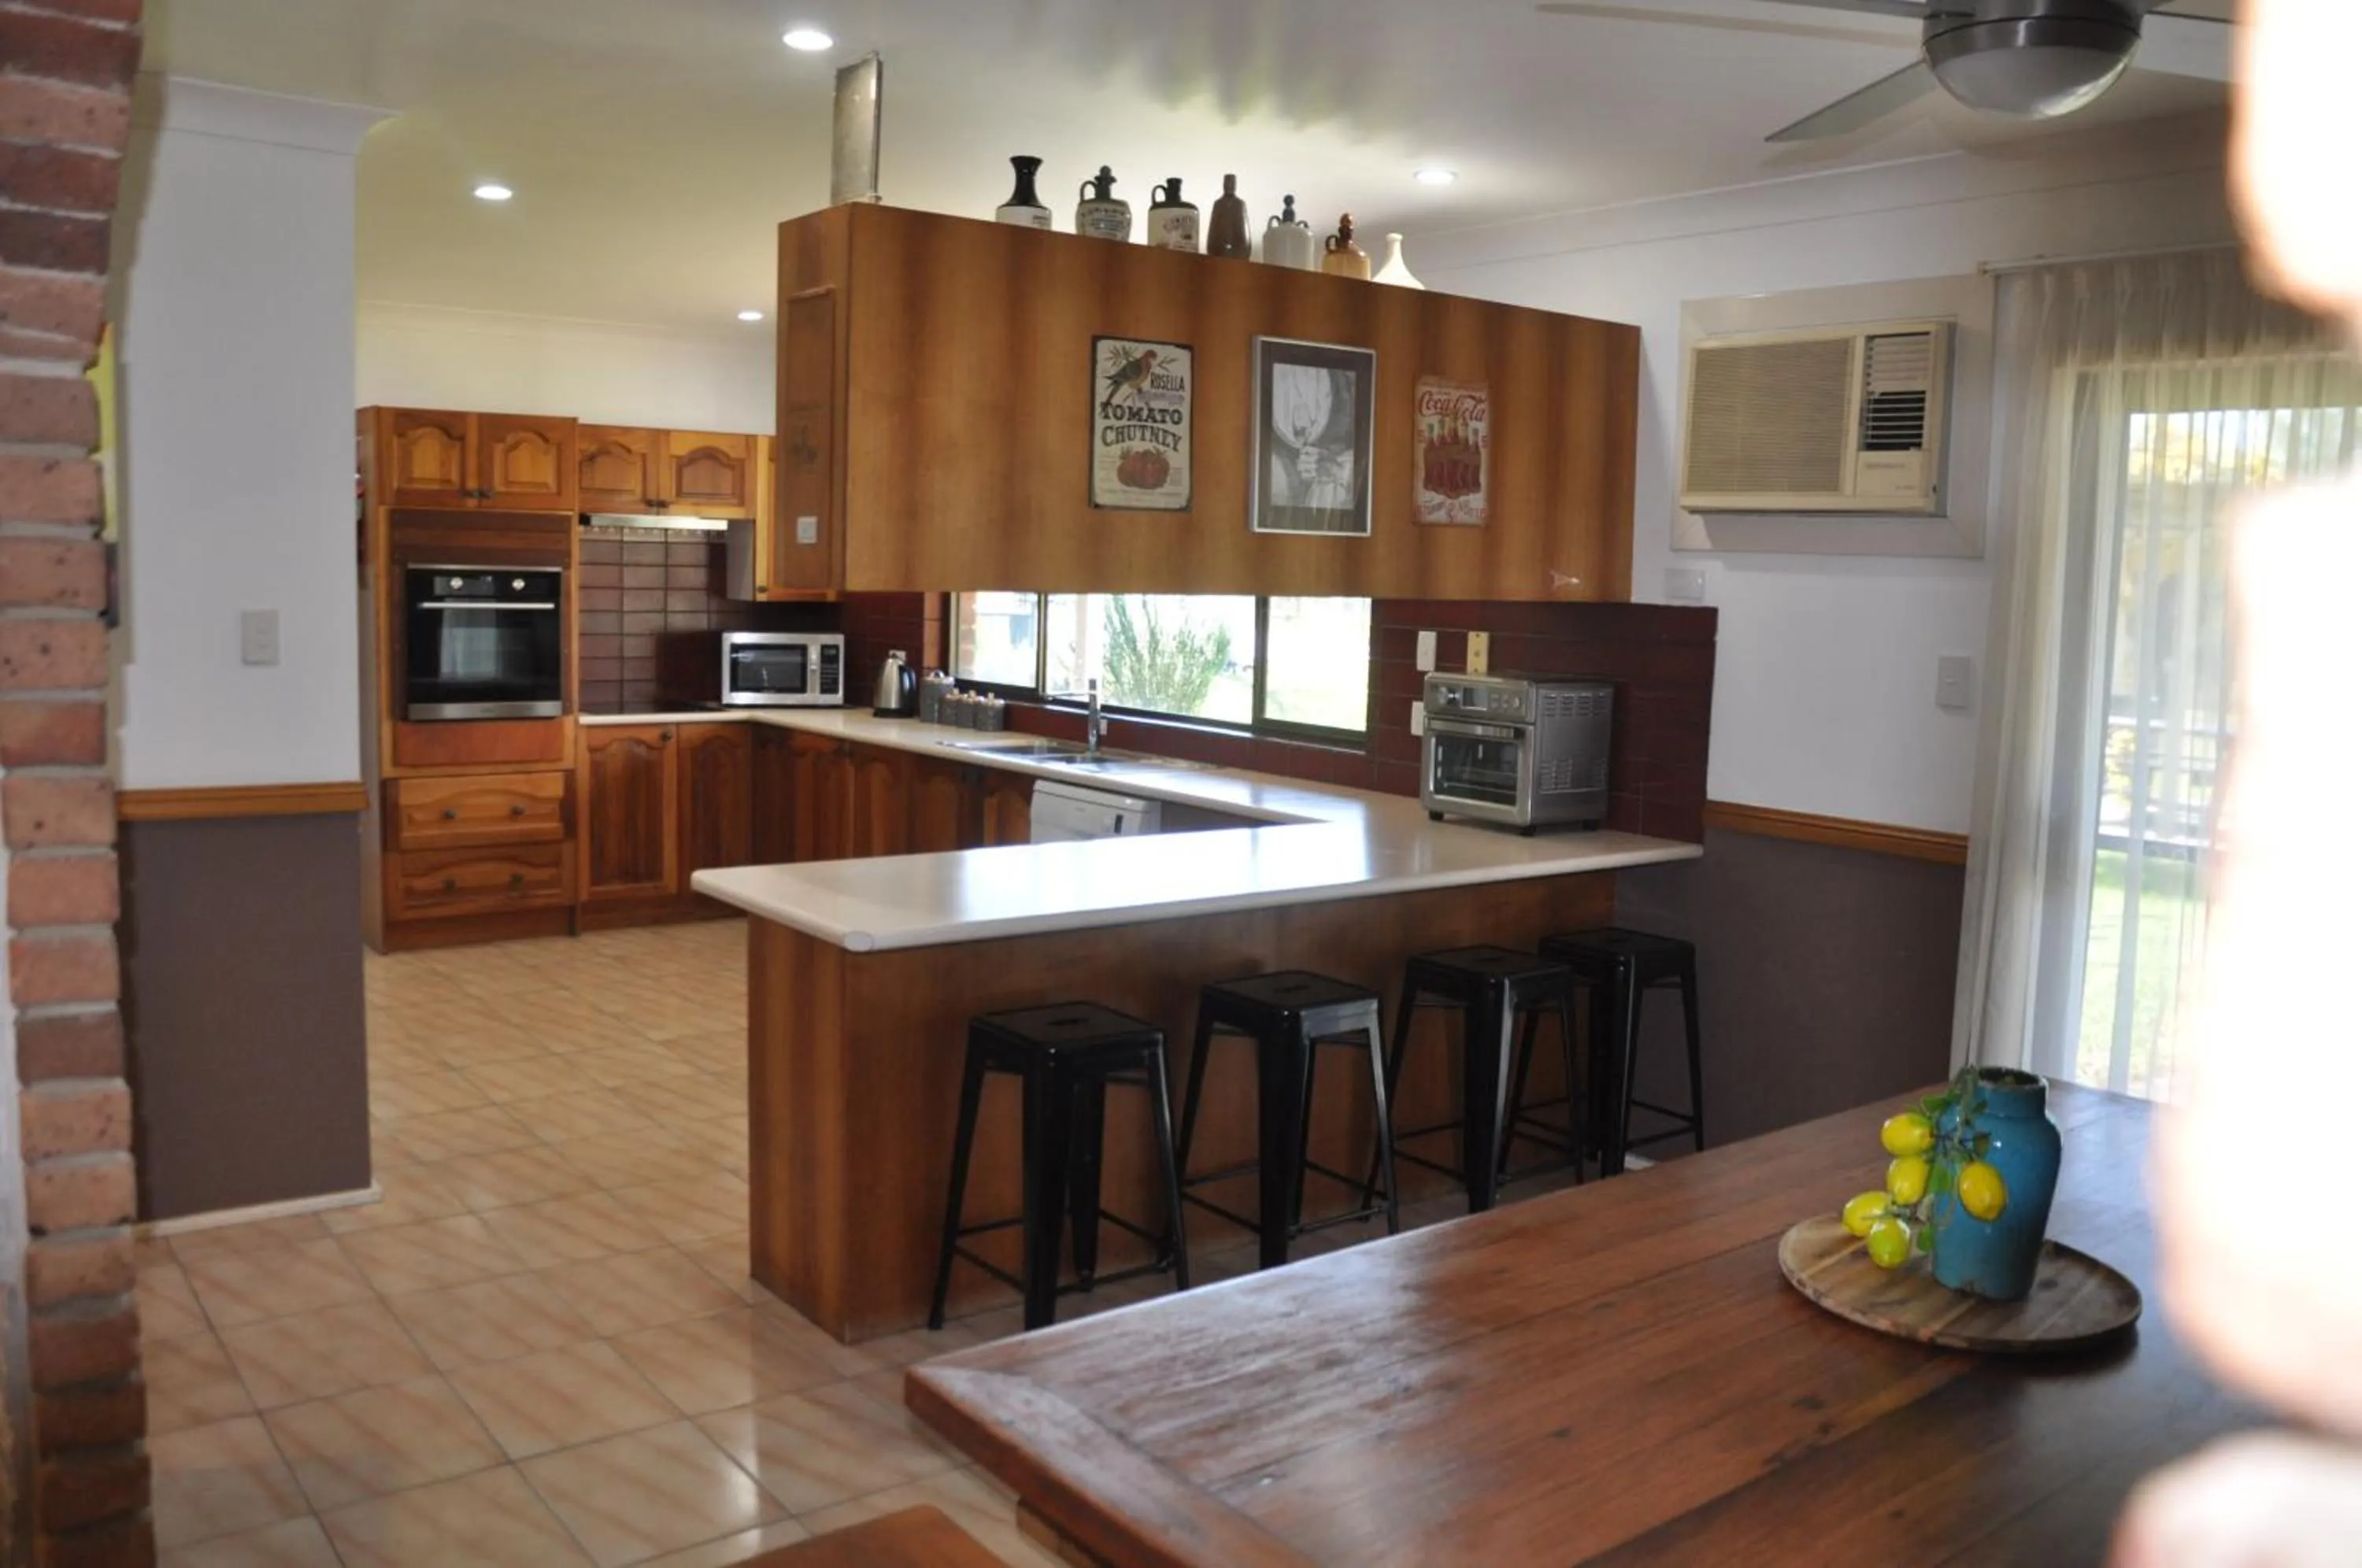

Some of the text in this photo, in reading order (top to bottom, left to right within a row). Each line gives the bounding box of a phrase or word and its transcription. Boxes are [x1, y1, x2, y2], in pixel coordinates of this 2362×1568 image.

[1150, 372, 1185, 392] ROSELLA
[1100, 401, 1183, 425] TOMATO
[1101, 423, 1182, 452] CHUTNEY
